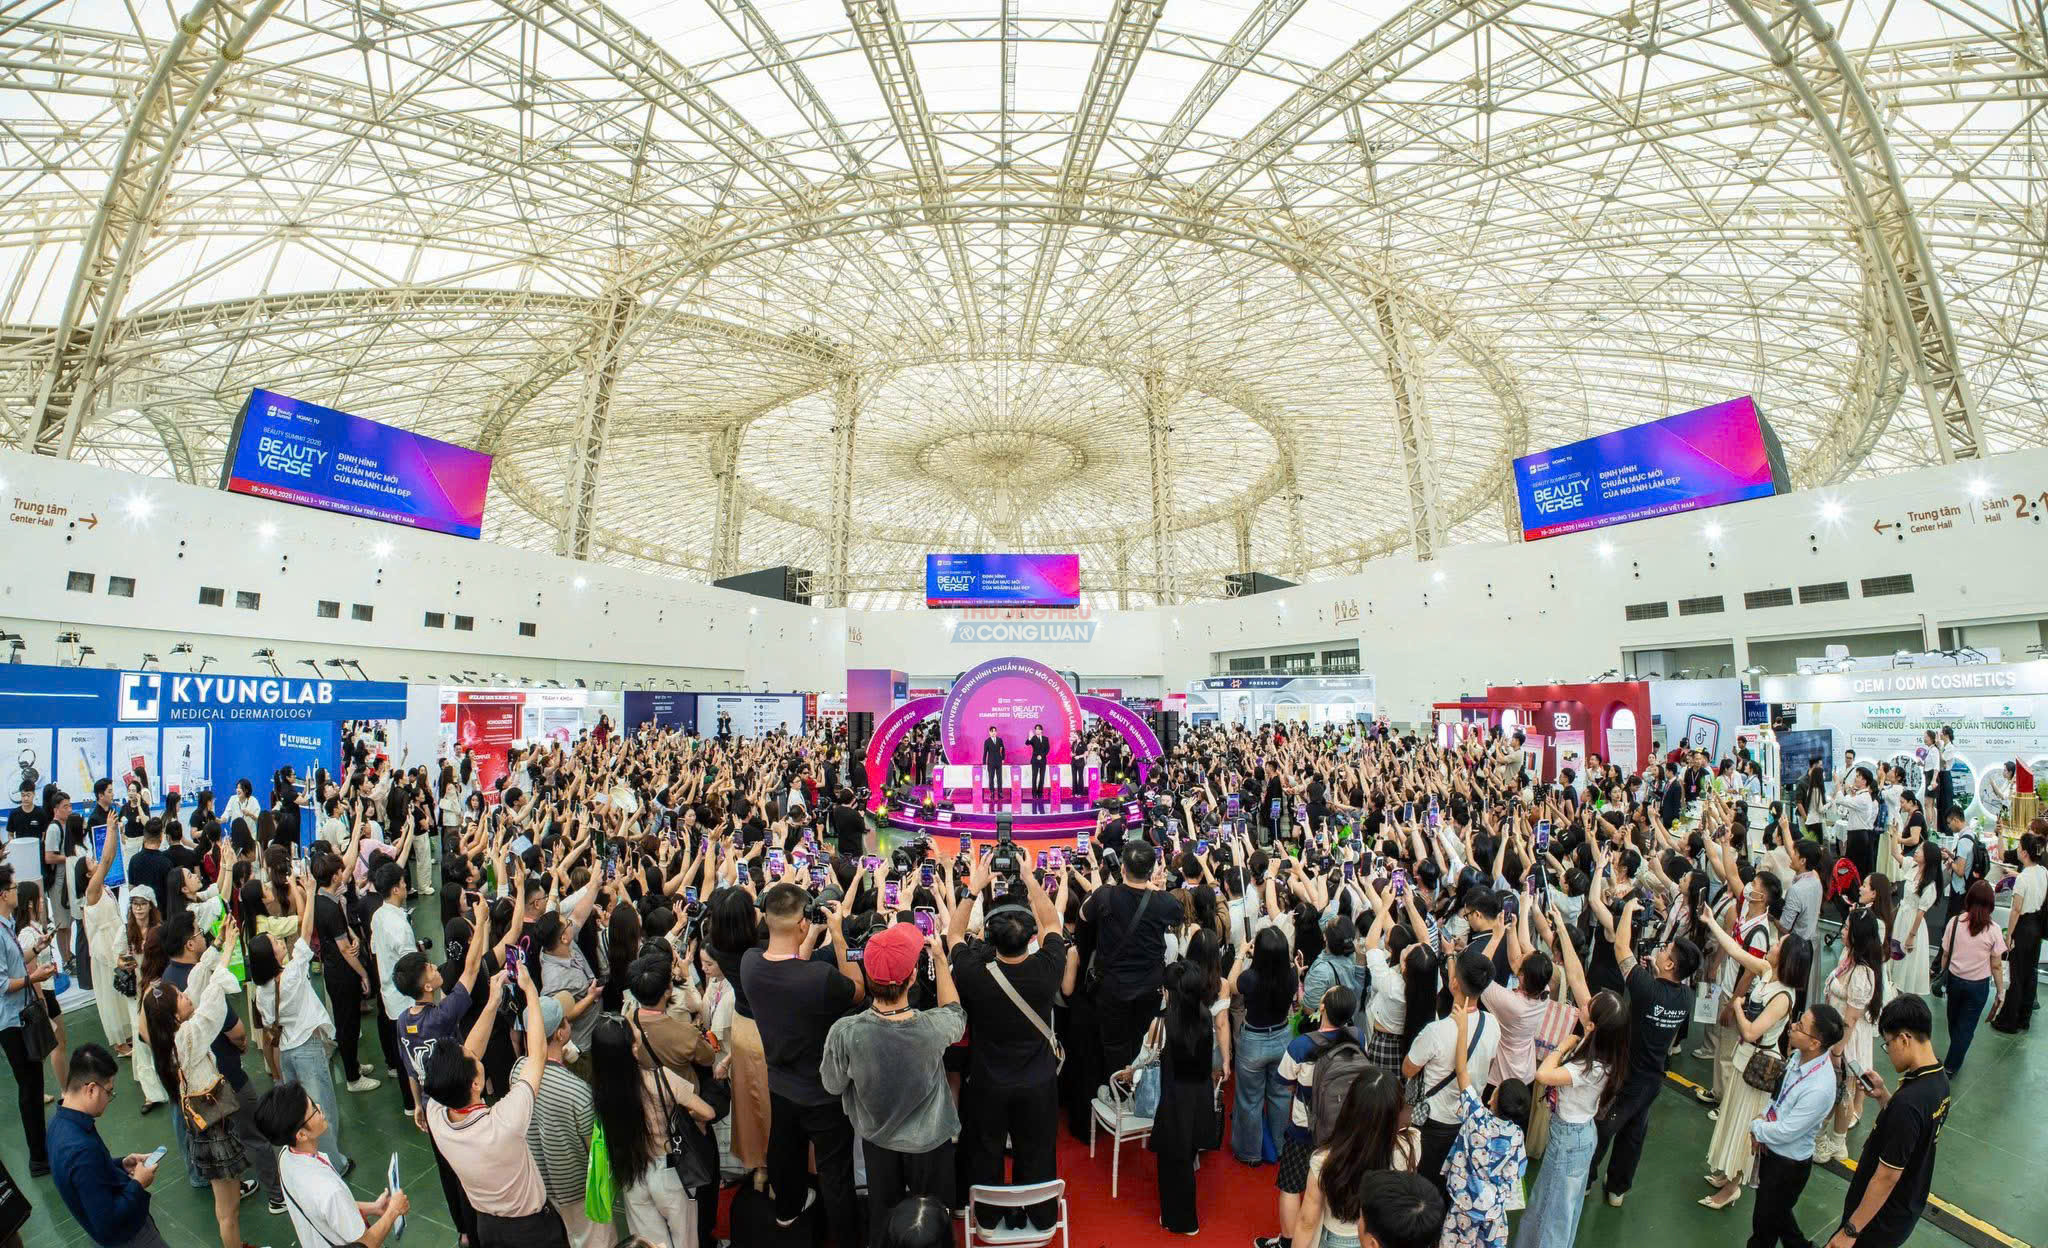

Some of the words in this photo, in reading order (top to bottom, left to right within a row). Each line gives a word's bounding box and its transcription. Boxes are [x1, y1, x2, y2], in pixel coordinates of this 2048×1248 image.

[264, 426, 284, 436] BEAUTY
[285, 432, 306, 442] SUMMIT
[259, 436, 328, 465] BEAUTY
[258, 452, 312, 477] VERSE
[338, 452, 358, 465] ĐỊNH
[358, 456, 377, 468] HÌNH
[336, 462, 364, 477] CHUẨN
[364, 470, 382, 482] MỰC
[383, 474, 398, 484] MỚI
[1600, 470, 1618, 480] ĐỊNH
[1619, 464, 1637, 474] HÌNH
[1601, 476, 1628, 488] CHUẨN
[1629, 473, 1646, 483] MỰC
[1648, 468, 1663, 479] MỚI
[334, 474, 351, 485] CỦA
[352, 477, 380, 490] NGÀNH
[380, 482, 396, 495] LÀM
[396, 488, 411, 499] ĐẸP
[1534, 478, 1590, 502] BEAUTY
[1603, 488, 1619, 498] CỦA
[1620, 483, 1648, 496] NGÀNH
[1666, 476, 1680, 486] ĐẸP
[14, 498, 44, 515] Trung
[47, 504, 67, 516] tâm
[1536, 494, 1584, 514] VERSE
[2012, 494, 2030, 518] 2
[10, 513, 36, 524] Center
[37, 517, 54, 527] Hall
[1907, 510, 1939, 521] Trung
[1940, 506, 1961, 517] tâm
[1984, 513, 2001, 522] Hall
[1910, 524, 1936, 533] Center
[1937, 520, 1953, 529] Hall
[937, 575, 976, 584] BEAUTY
[938, 584, 969, 592] VERSE
[976, 669, 991, 681] HÌNH
[992, 662, 1017, 673] CHUẨN
[1018, 665, 1034, 674] MỰC
[1035, 670, 1048, 681] MỚI
[1048, 679, 1060, 693] CỦA
[1895, 677, 1927, 691] ODM
[1931, 672, 2017, 690] COSMETICS
[172, 676, 333, 704] KYUNGLAB
[170, 709, 225, 719] MEDICAL
[230, 709, 312, 719] DERMATOLOGY
[1109, 710, 1130, 727] BEAUTY
[1129, 725, 1147, 749] SUMMIT
[1861, 720, 1887, 729] NGHIÊN
[1910, 719, 1925, 729] SẢN
[1980, 720, 2014, 729] THƯƠNG
[2016, 719, 2036, 731] HIỆU
[288, 735, 321, 746] KYUNGLAB
